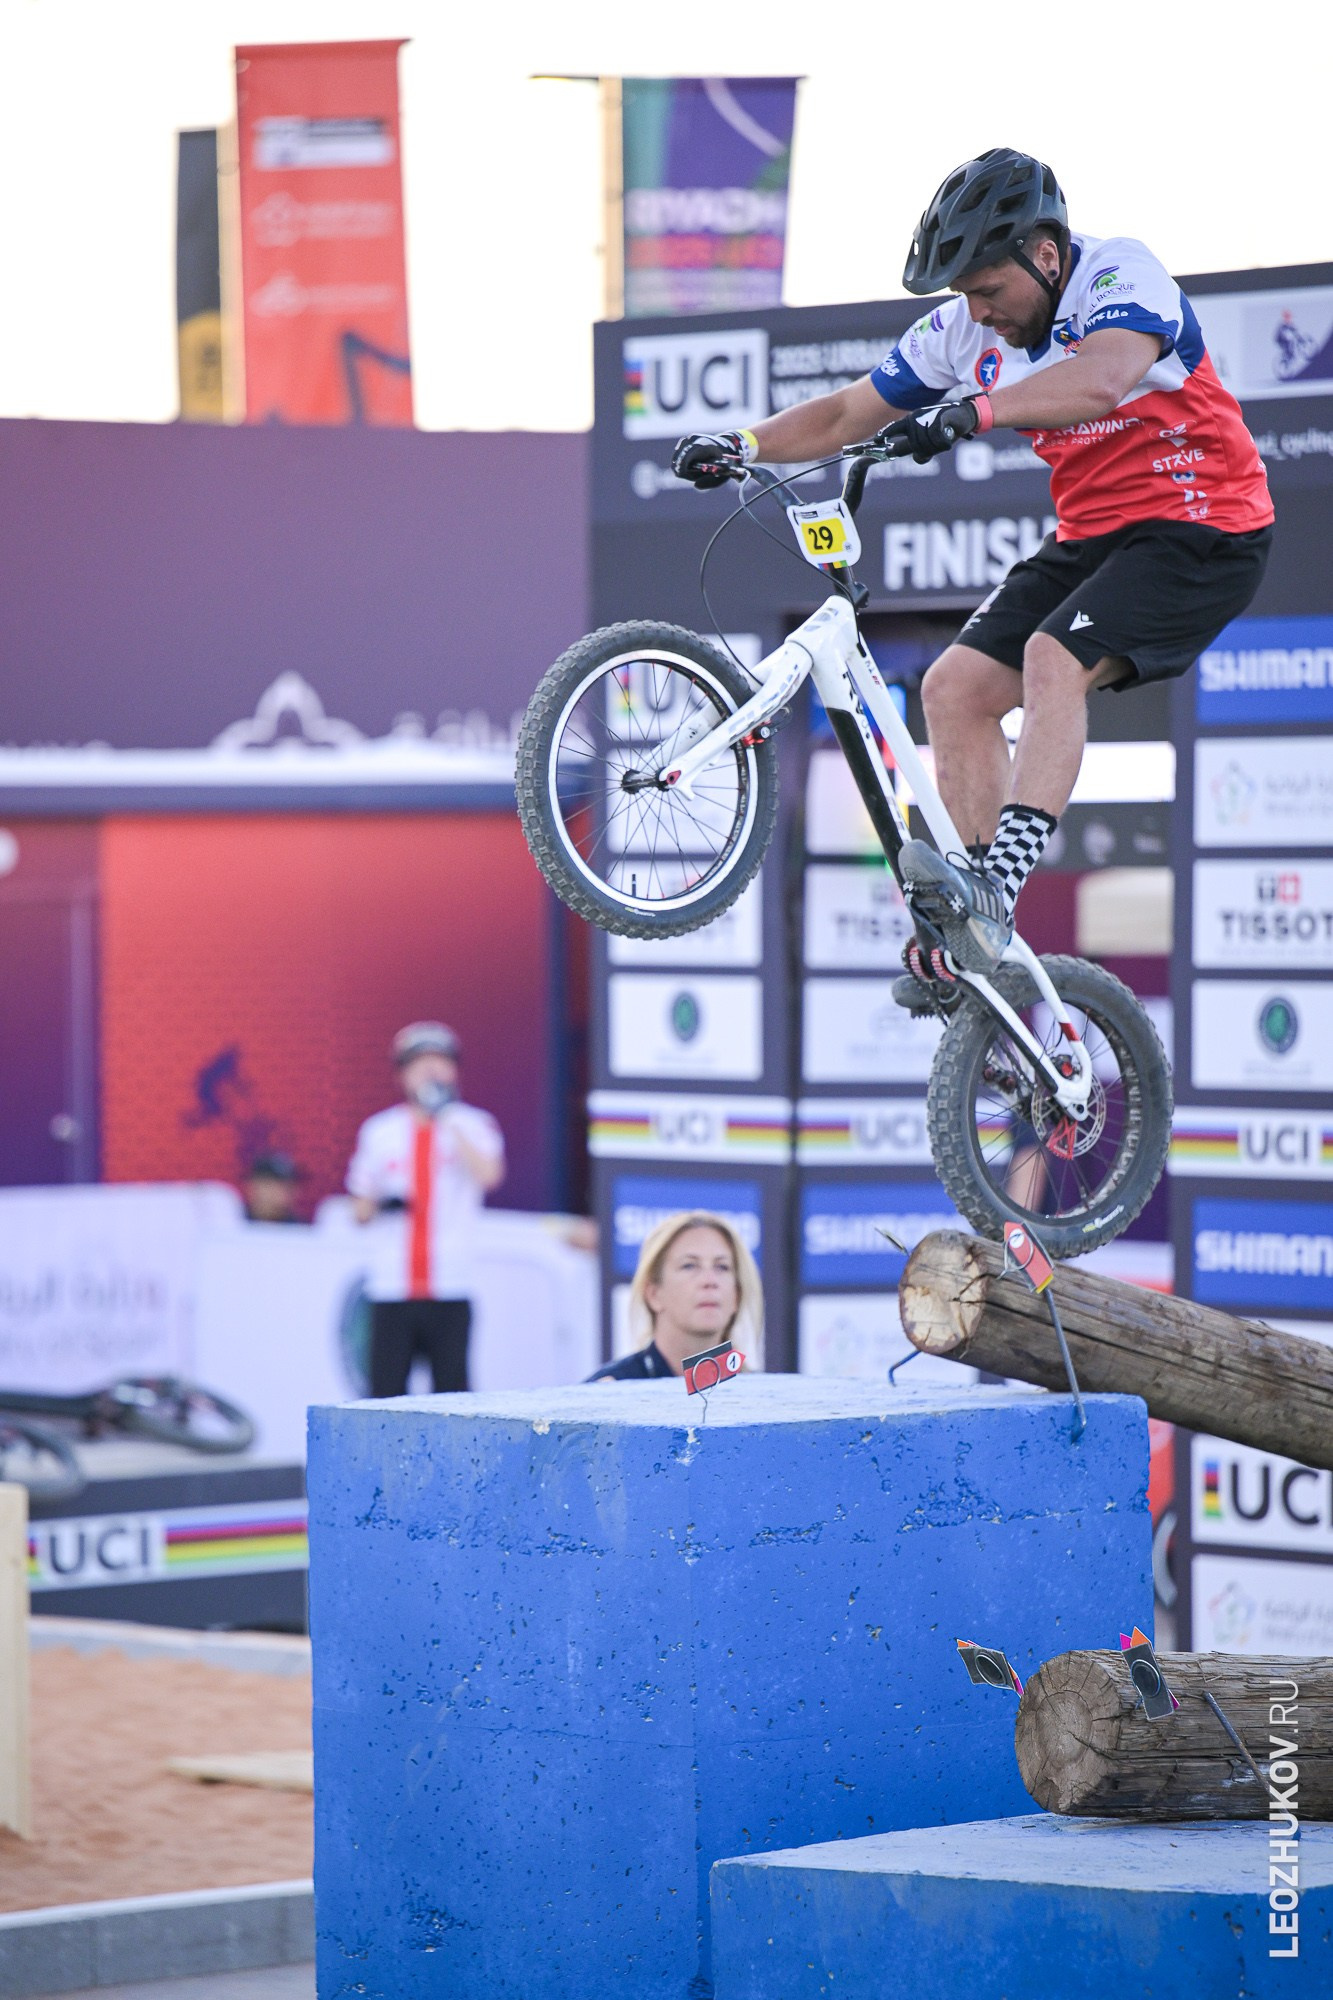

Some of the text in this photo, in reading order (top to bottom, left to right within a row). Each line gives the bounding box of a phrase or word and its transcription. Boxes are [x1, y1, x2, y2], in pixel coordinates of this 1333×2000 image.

[653, 353, 750, 413] UCI
[808, 525, 833, 550] 29
[1244, 1126, 1309, 1161] UCI
[729, 1355, 736, 1369] 1
[50, 1527, 148, 1575] UCI
